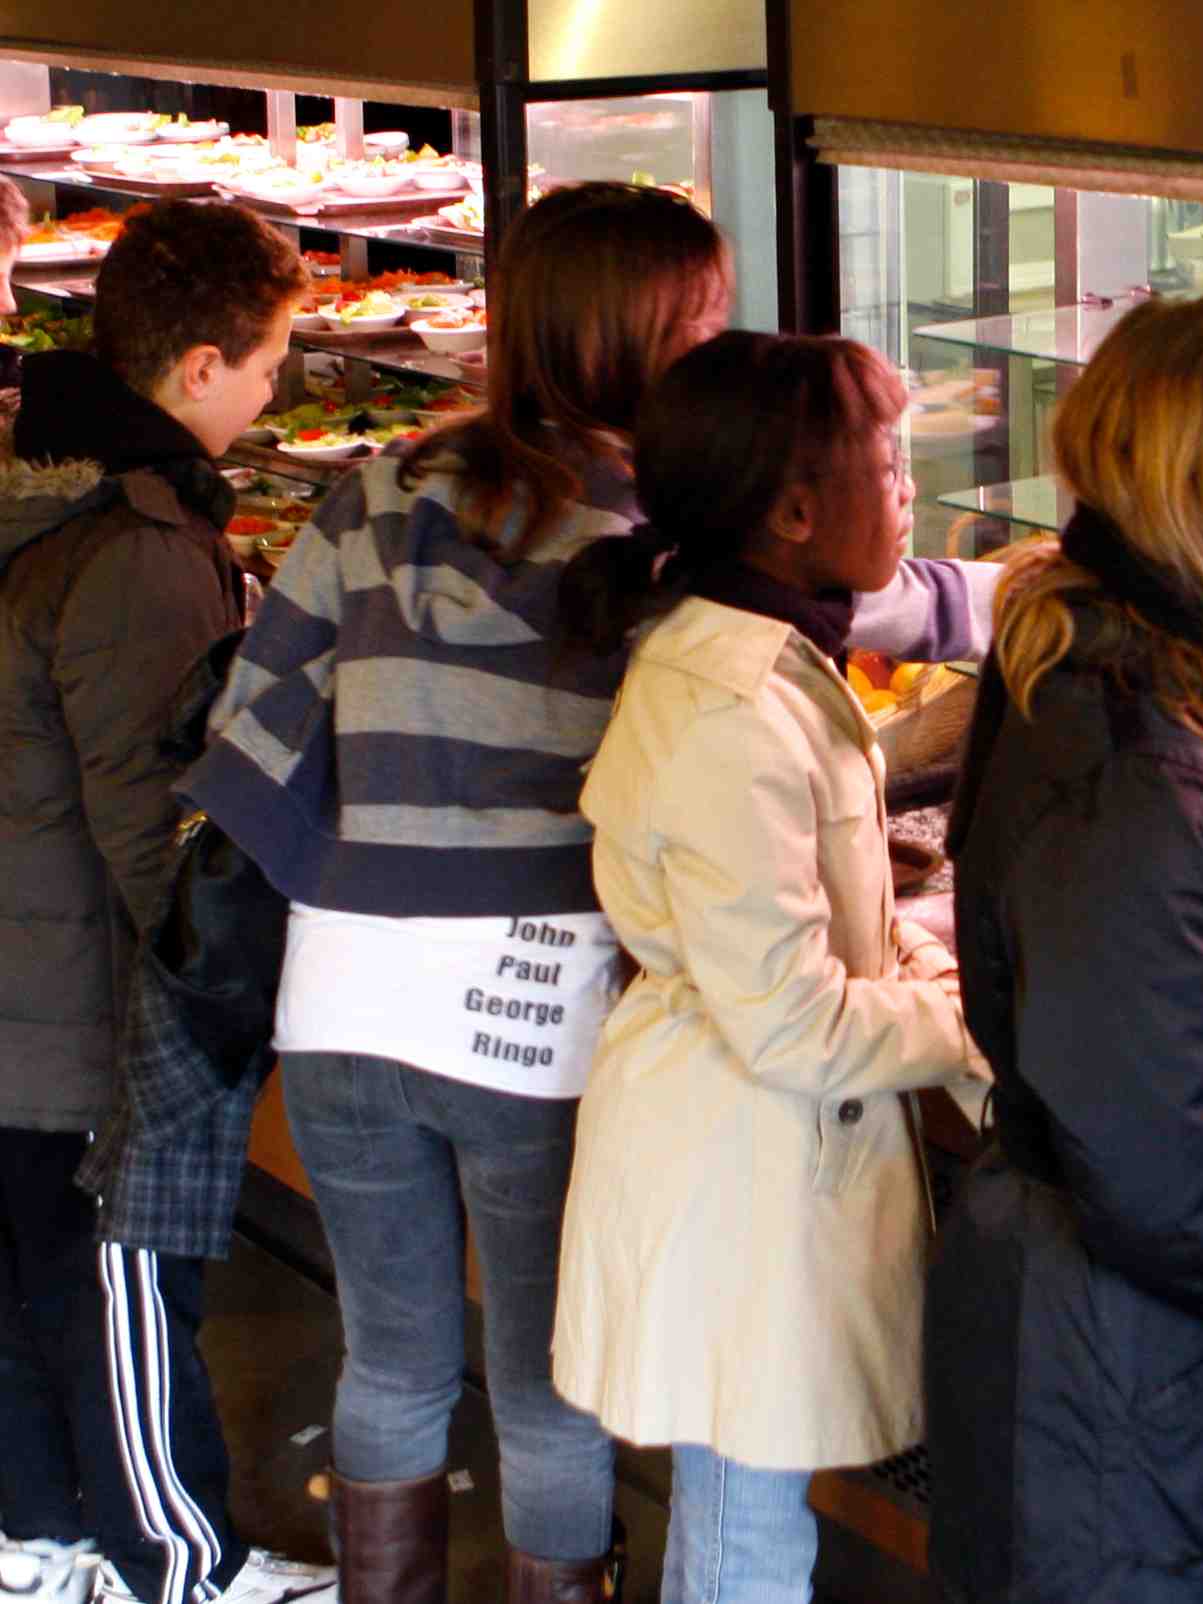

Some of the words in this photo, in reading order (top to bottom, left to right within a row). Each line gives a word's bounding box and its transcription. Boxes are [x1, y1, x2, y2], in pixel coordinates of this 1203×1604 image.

[506, 917, 576, 947] John
[496, 955, 562, 986] Paul
[464, 987, 565, 1026] George
[472, 1031, 554, 1067] Ringo
